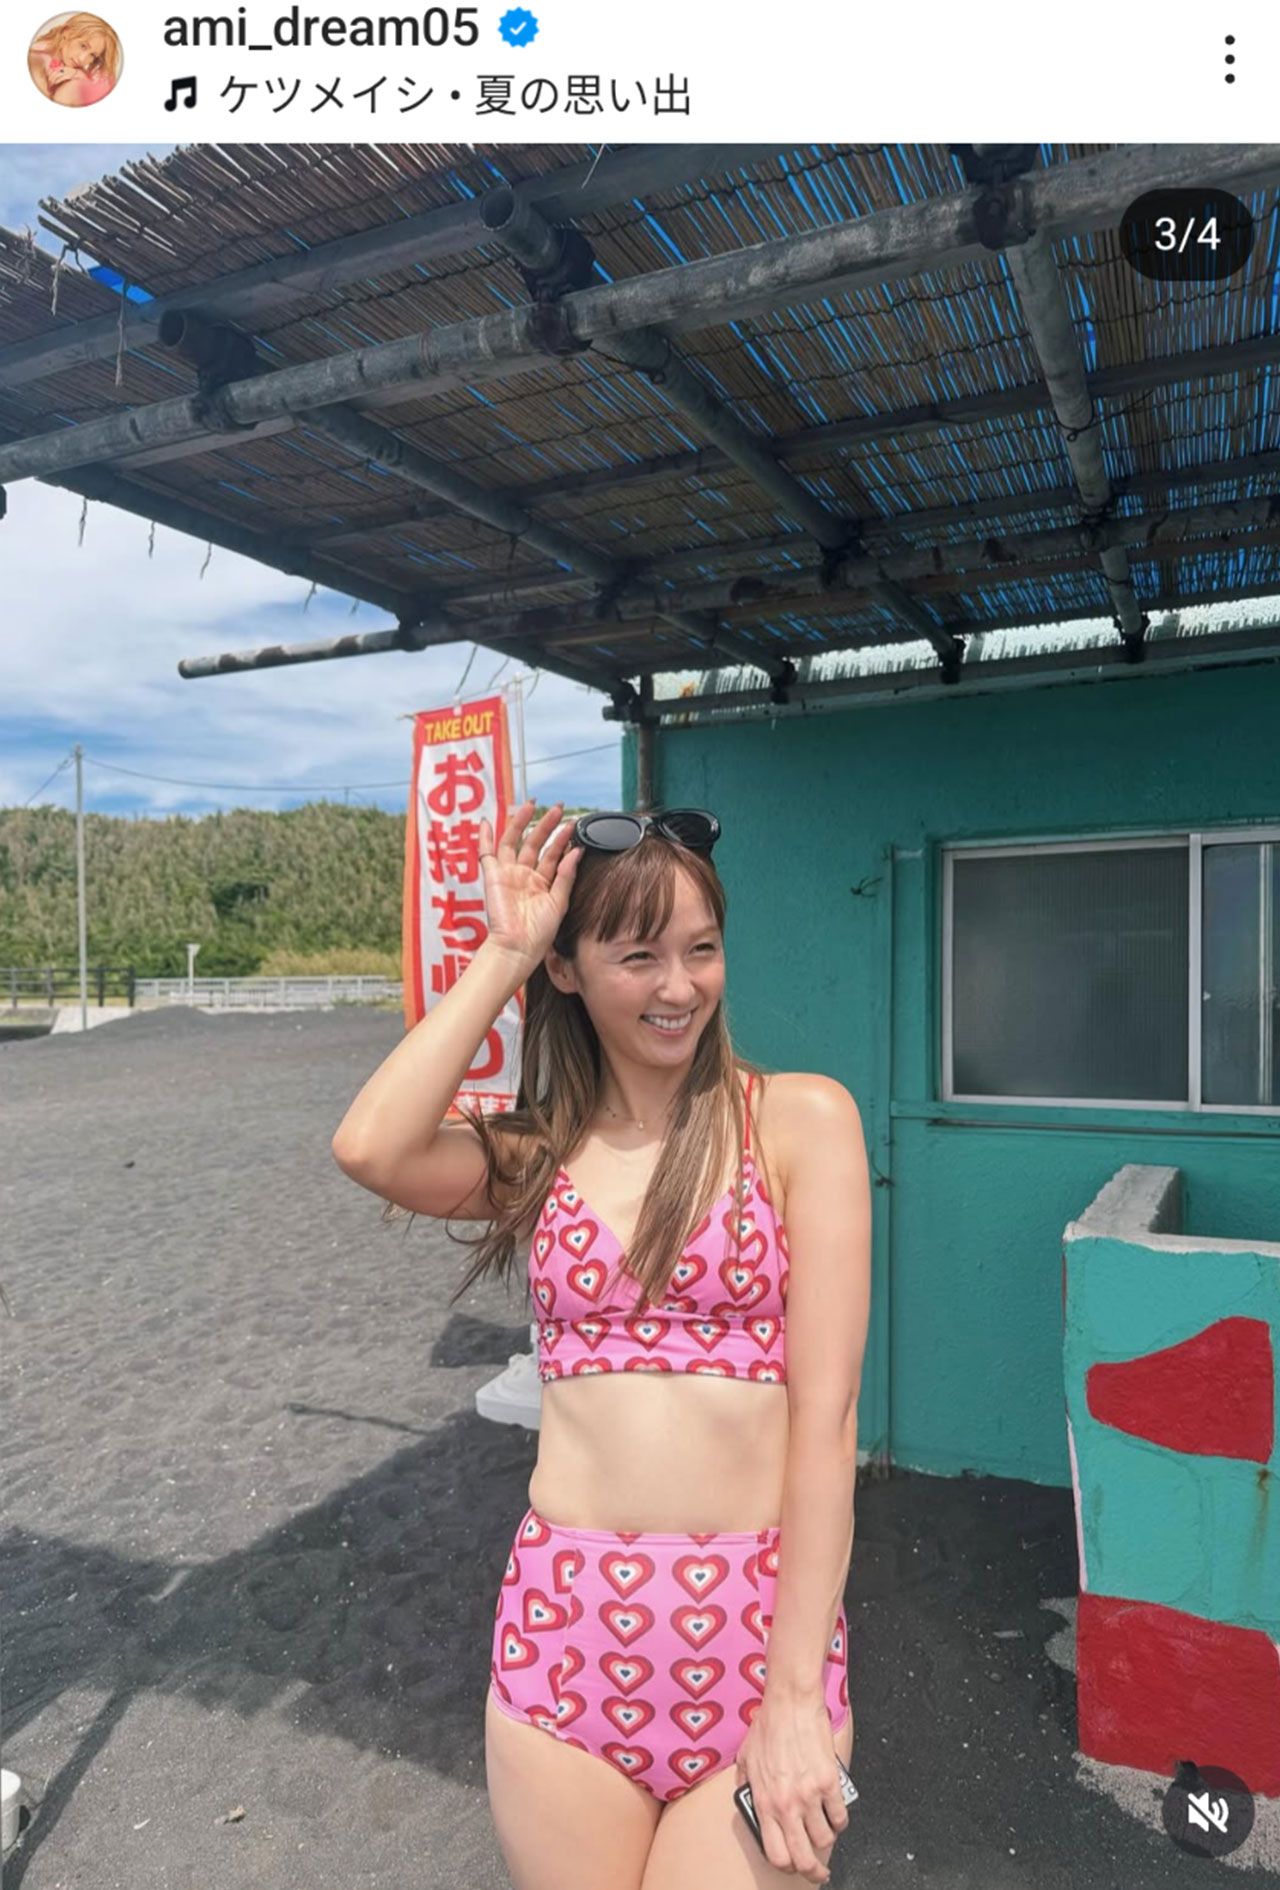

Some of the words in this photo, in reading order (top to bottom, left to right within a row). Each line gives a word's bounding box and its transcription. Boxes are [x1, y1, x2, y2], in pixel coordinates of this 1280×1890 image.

[425, 718, 462, 743] TAKE
[463, 711, 494, 736] OUT
[427, 750, 505, 1081] お持ち
